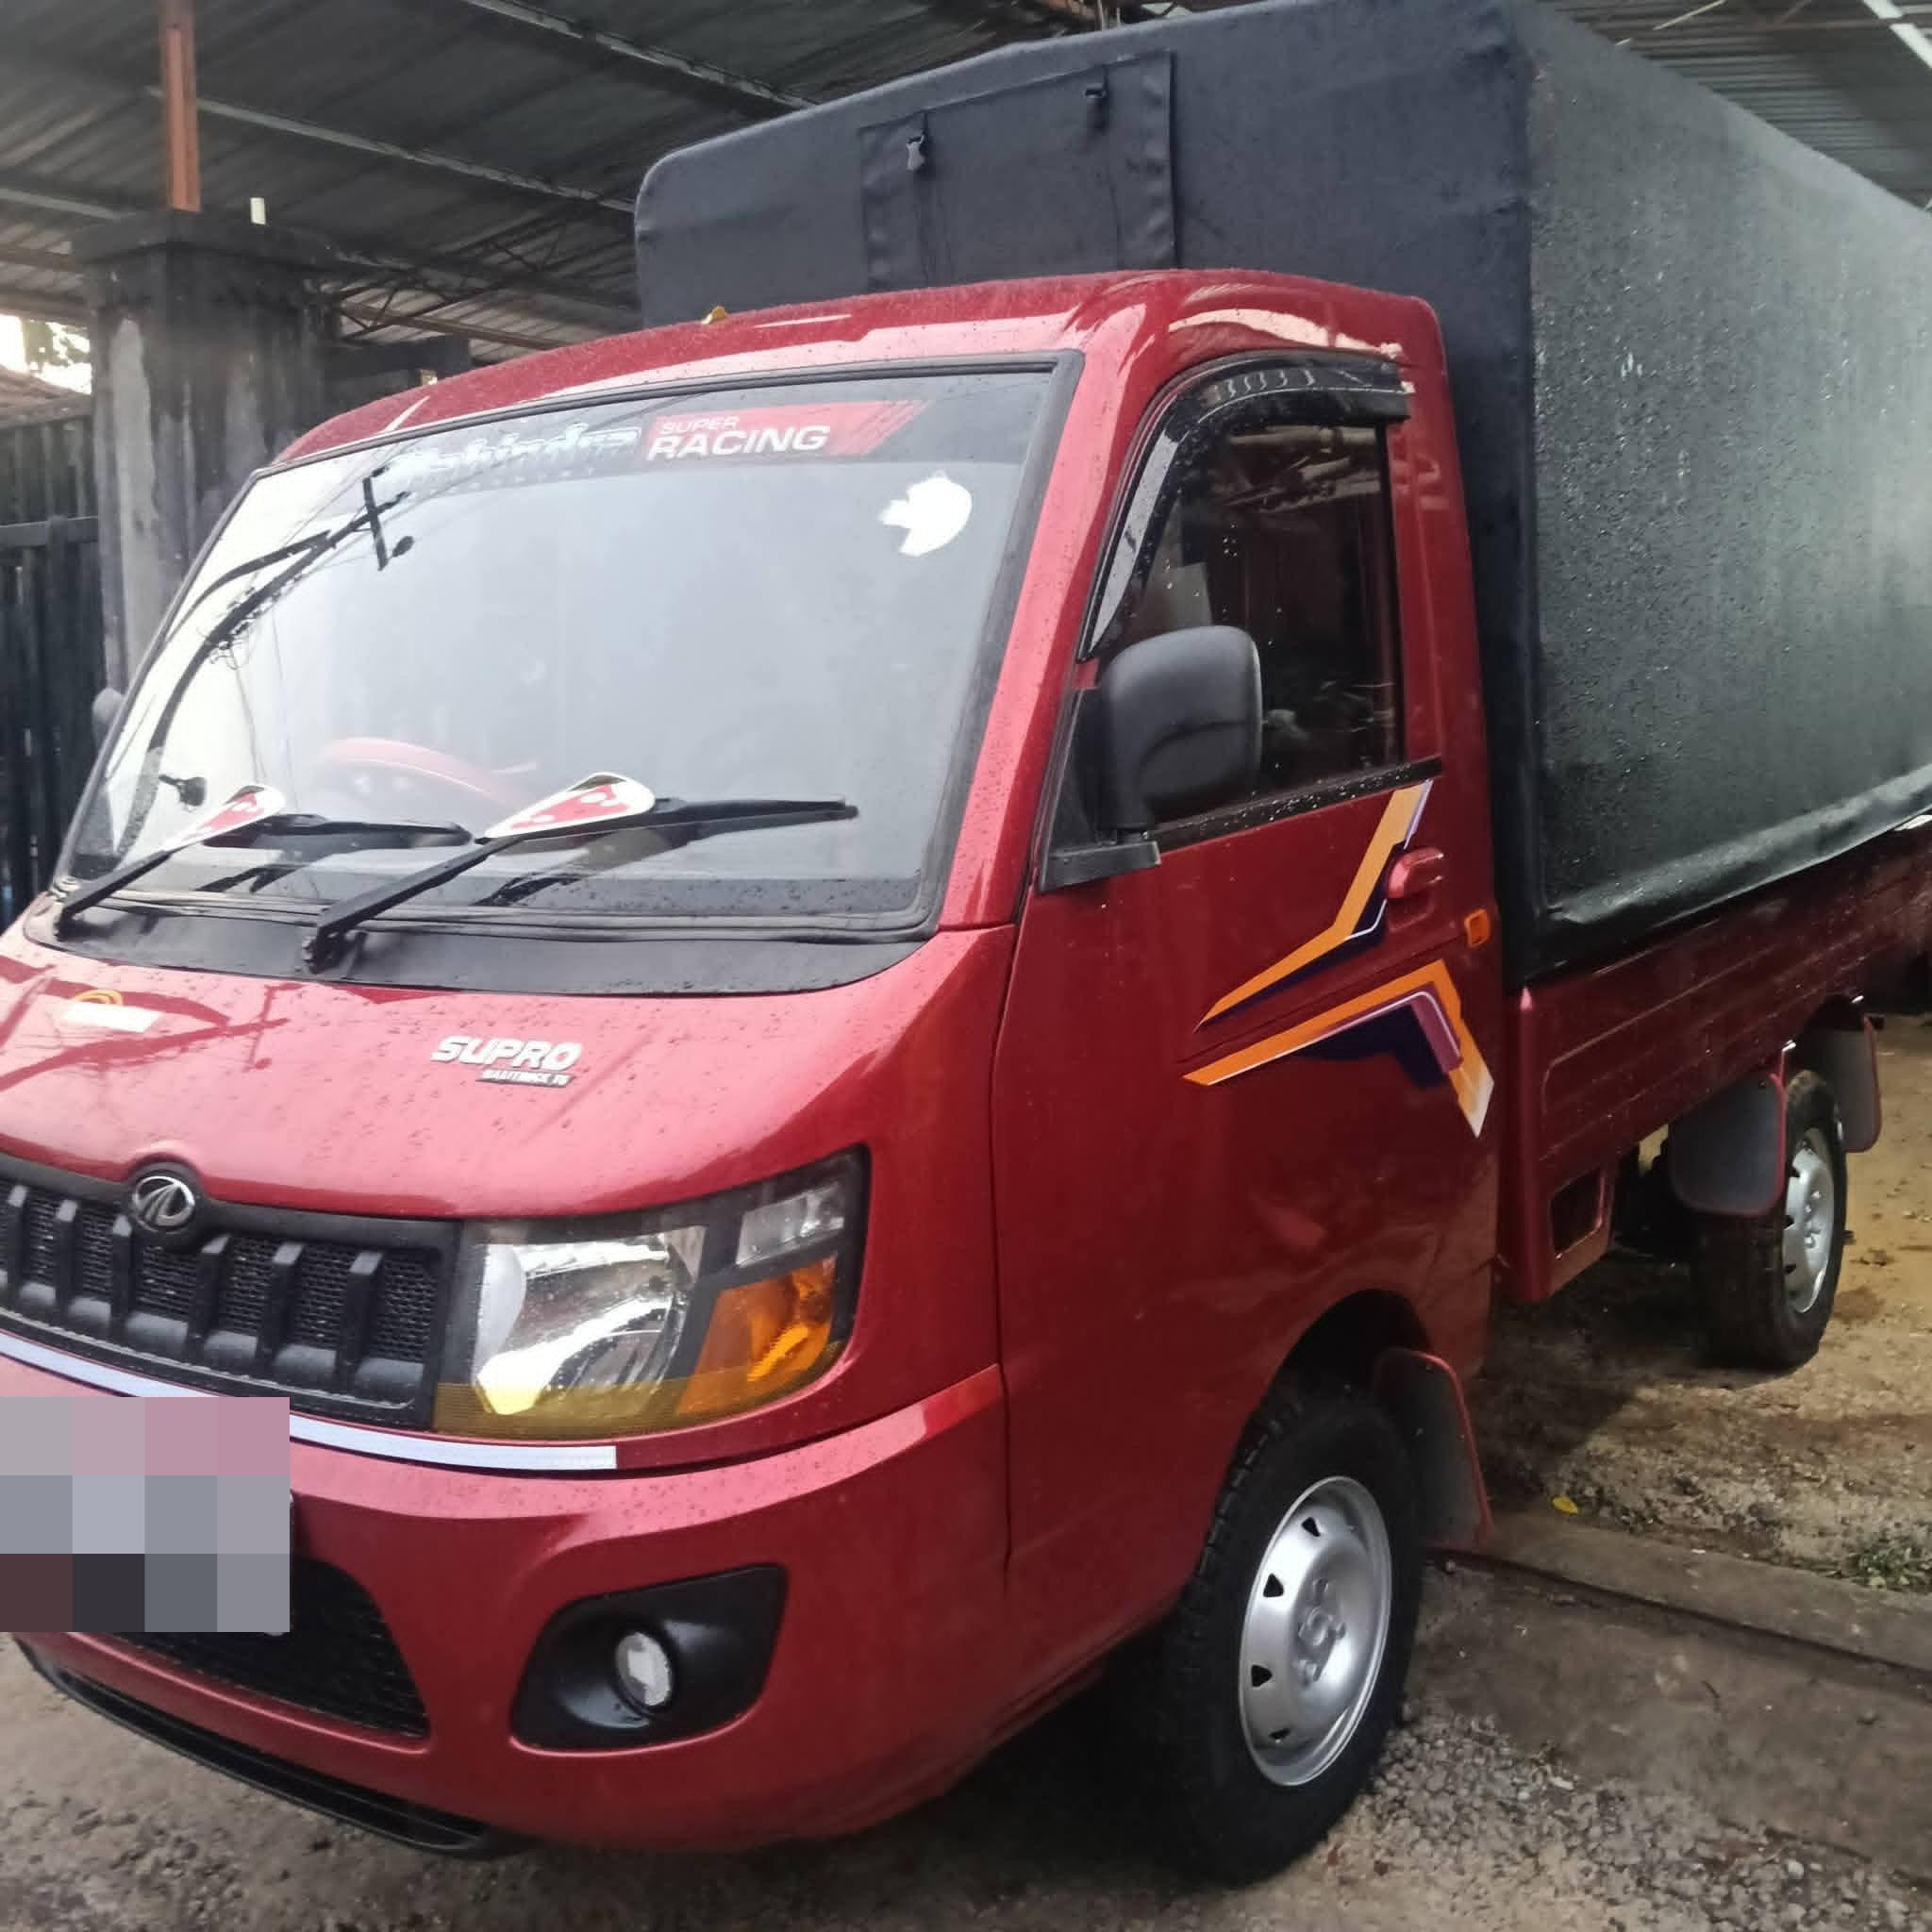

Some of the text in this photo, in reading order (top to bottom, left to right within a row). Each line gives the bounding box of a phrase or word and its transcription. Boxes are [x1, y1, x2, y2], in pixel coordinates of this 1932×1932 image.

[646, 425, 830, 460] RACING
[659, 416, 740, 435] SUPER
[431, 1036, 582, 1072] SUPRO
